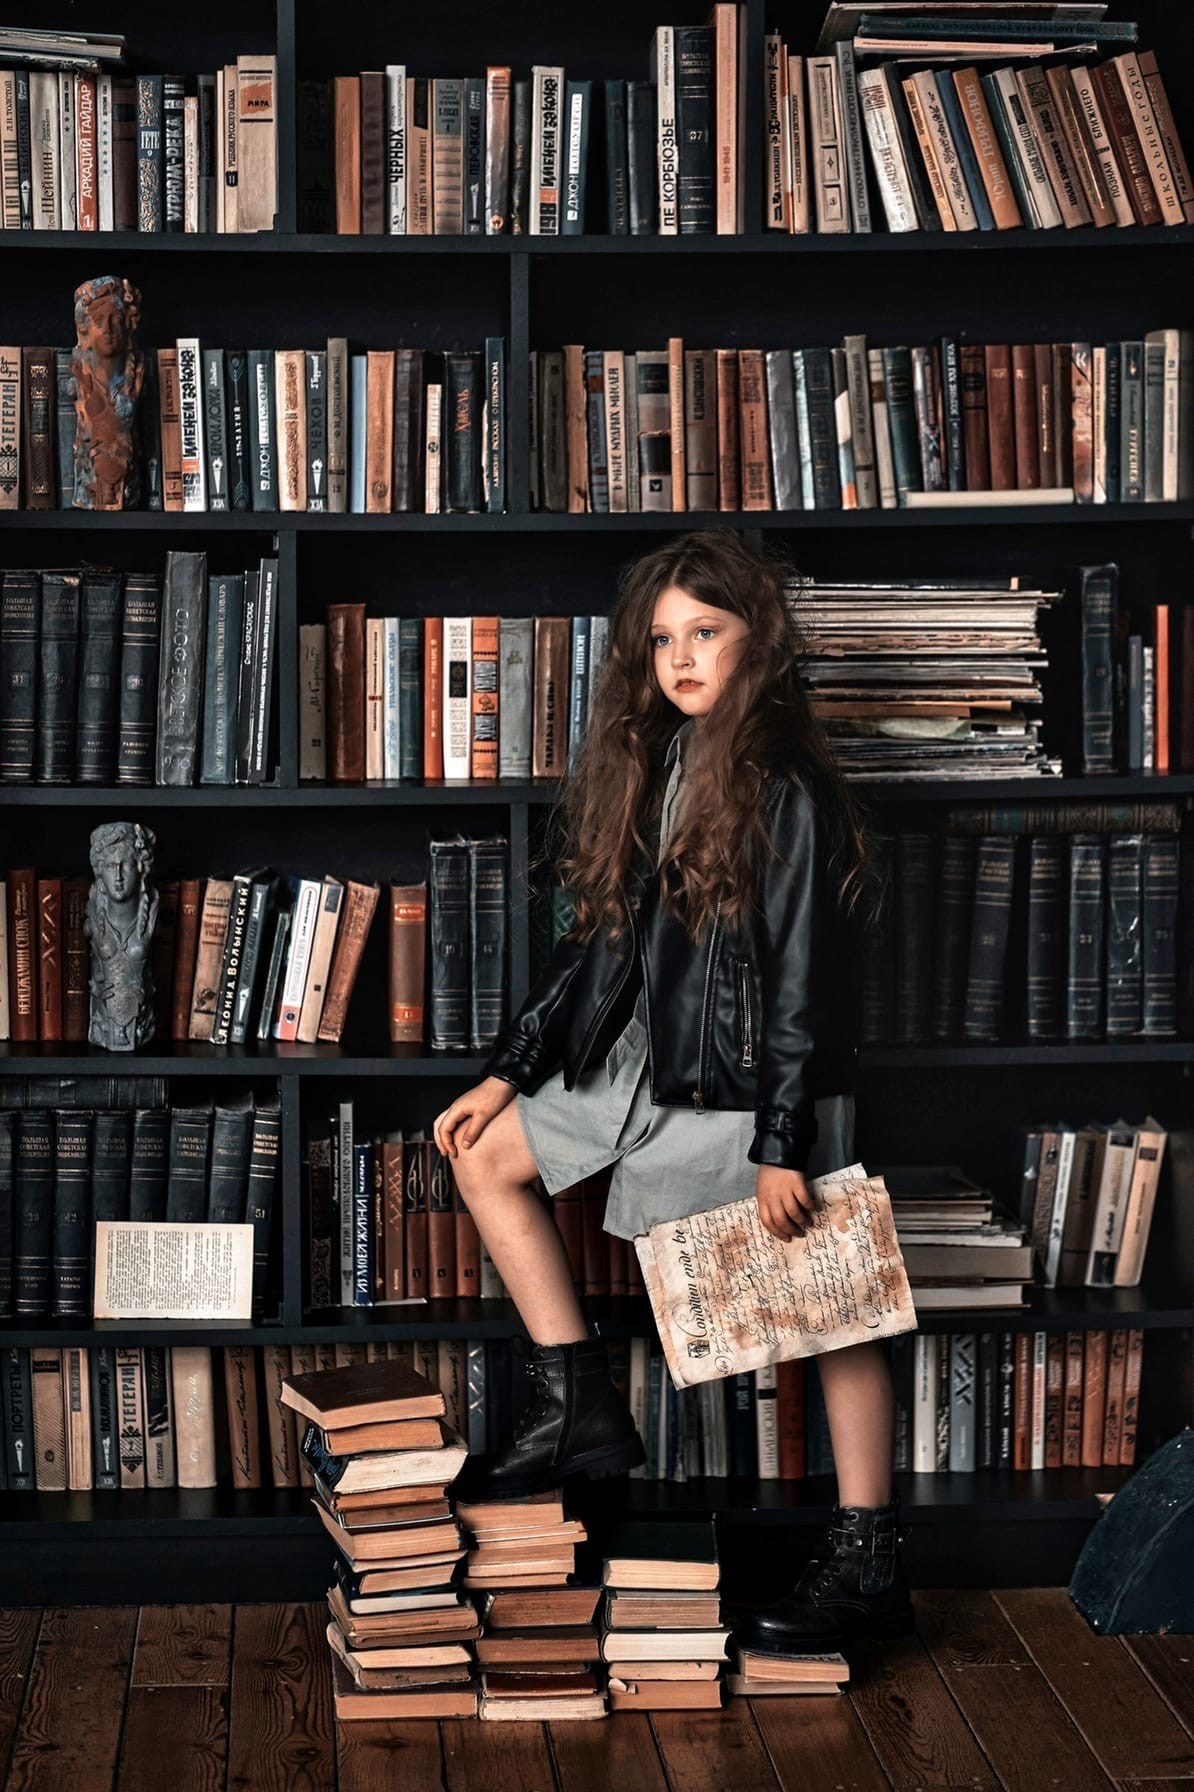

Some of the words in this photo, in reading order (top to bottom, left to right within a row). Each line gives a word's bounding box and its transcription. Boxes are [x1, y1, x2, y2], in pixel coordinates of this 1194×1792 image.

[80, 85, 92, 133] ГАЙДАР
[248, 99, 269, 107] МИРА
[1080, 88, 1102, 139] БЛИЖНЕГО
[1127, 66, 1147, 110] ГОДЫ
[469, 116, 481, 175] ПЕРОВСКАЯ
[964, 84, 994, 158] ТРИФОНОВ
[79, 138, 93, 198] АРКАДИЙ
[165, 117, 183, 222] УГРЮМ-РЕКА
[389, 129, 403, 183] ЧЕРНЫХ
[662, 119, 674, 202] КОРБЮЗЬЕ
[1142, 115, 1175, 207] ШКОЛЬНЫЕ
[42, 152, 54, 214] Шейнин
[567, 175, 579, 210] ДЖОН
[2, 384, 15, 443] ТЕГЕРАН
[608, 368, 619, 407] МЫСЛЕЙ
[311, 397, 321, 449] ЧЕХОВ
[609, 410, 620, 451] МУДРЫХ
[259, 445, 271, 479] ДЖОН
[611, 454, 622, 481] МИРЕ
[174, 608, 189, 662] ФОТО
[15, 918, 30, 947] СПОК
[16, 949, 31, 1015] БЕНДЖАМИН
[255, 1208, 266, 1219] 51
[356, 1200, 368, 1241] ЖИЗНИ
[356, 1243, 368, 1276] МОЕЙ
[357, 1278, 368, 1293] ИЗ
[11, 1363, 24, 1433] ПОРТРЕТЫ
[99, 1372, 111, 1432] РАХМАНИНОВ
[122, 1367, 136, 1424] ТЕГЕРАН
